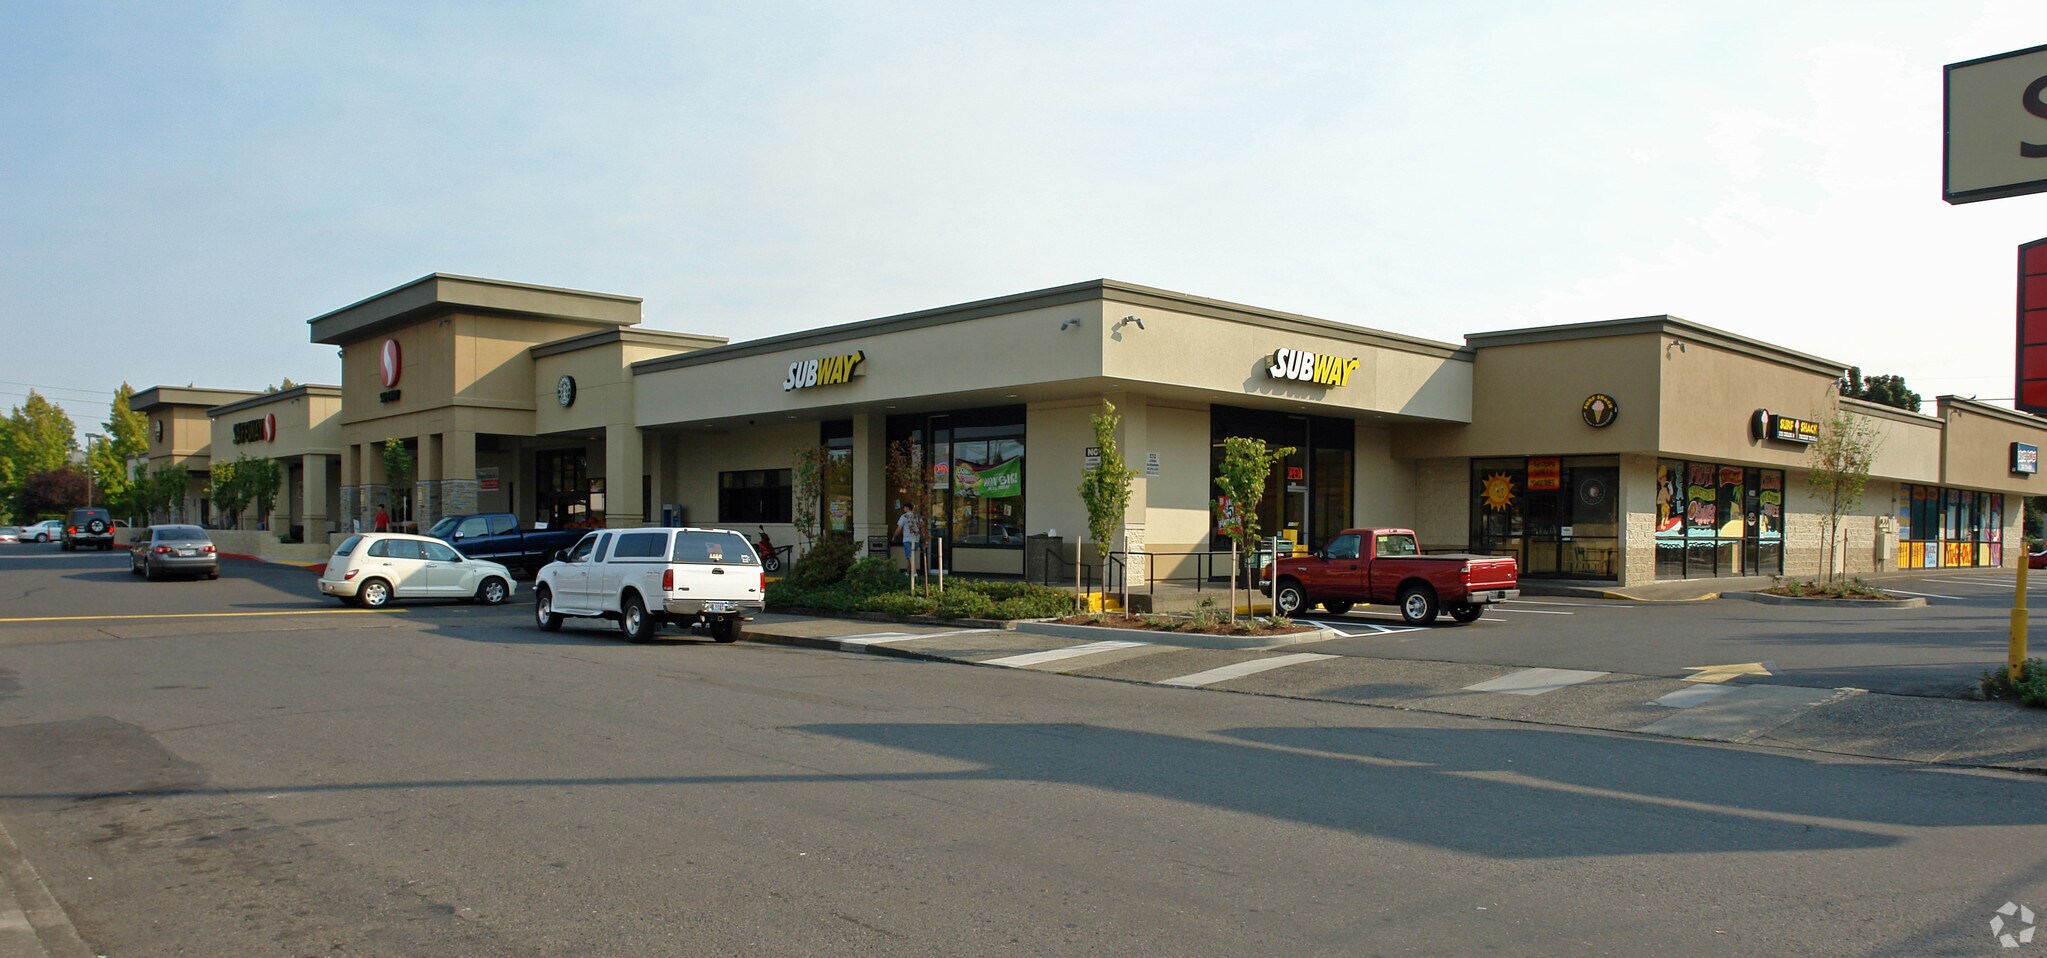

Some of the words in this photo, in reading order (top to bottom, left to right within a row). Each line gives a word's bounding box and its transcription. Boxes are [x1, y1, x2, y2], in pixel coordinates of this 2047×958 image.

[783, 351, 863, 390] SUBWAY
[1269, 347, 1361, 387] SUBWAY
[233, 419, 264, 444] SAFEWAY
[1779, 418, 1794, 431] SURF
[1800, 421, 1818, 436] SHACK
